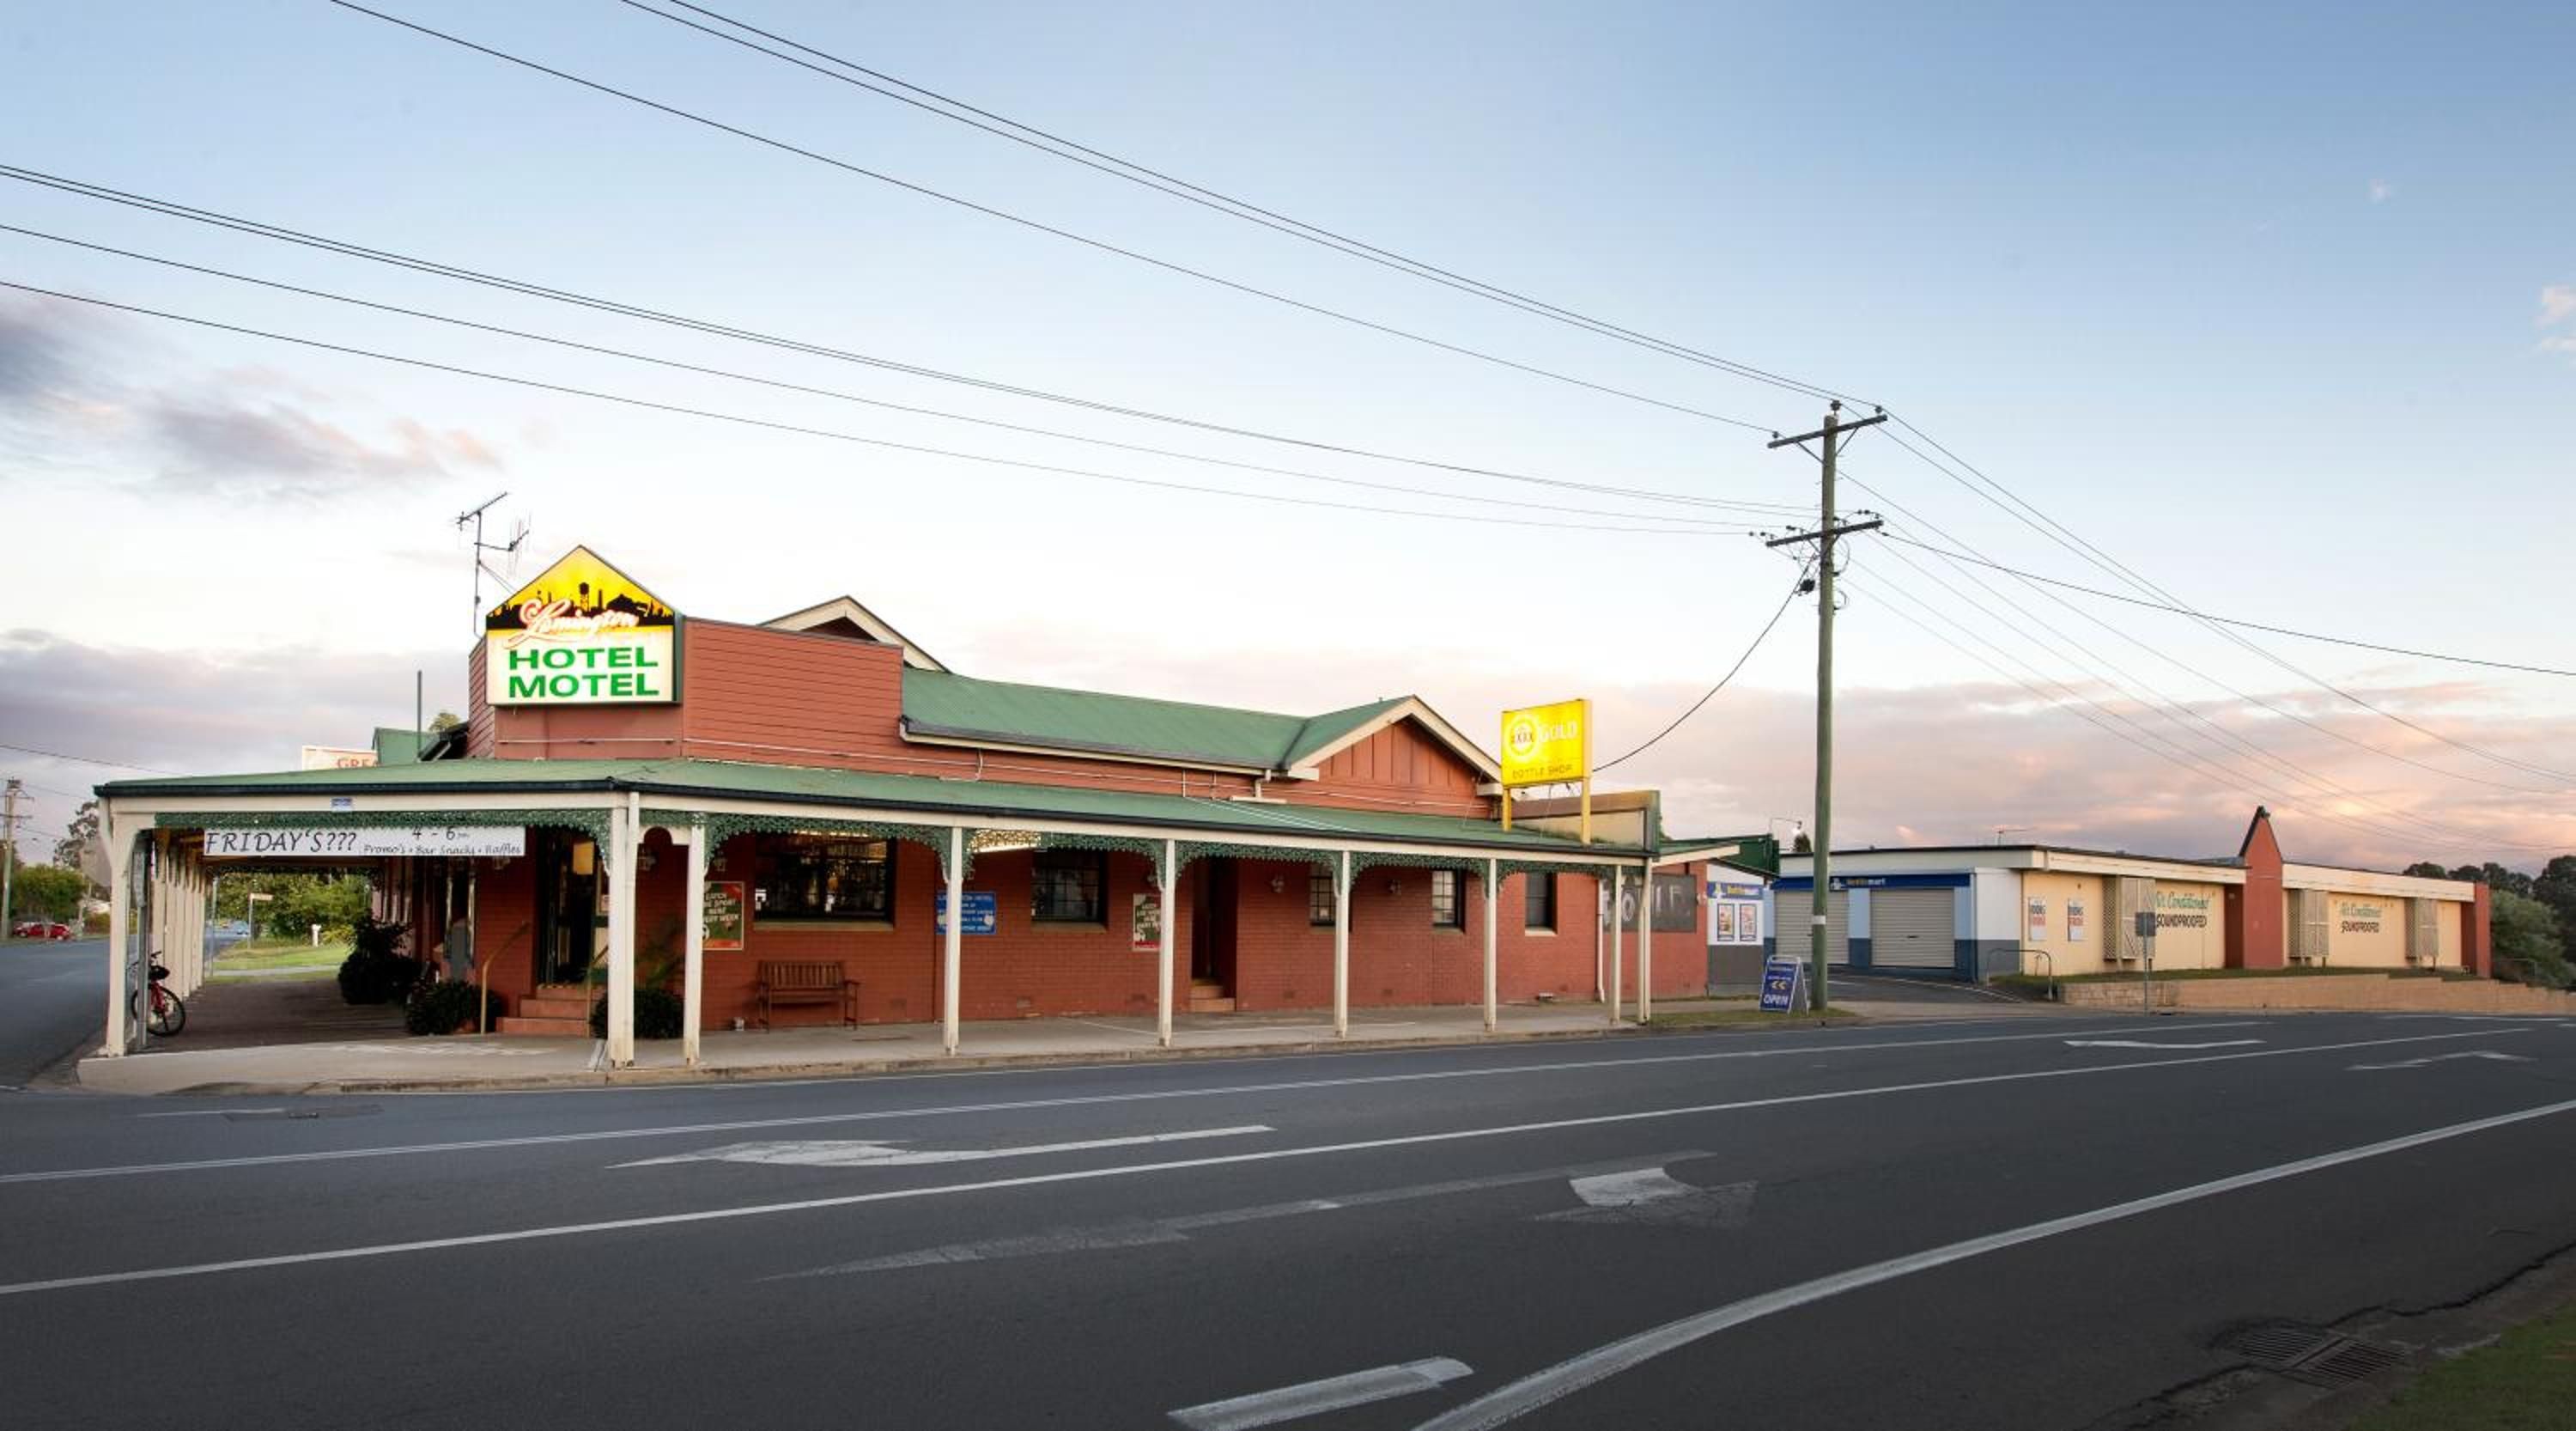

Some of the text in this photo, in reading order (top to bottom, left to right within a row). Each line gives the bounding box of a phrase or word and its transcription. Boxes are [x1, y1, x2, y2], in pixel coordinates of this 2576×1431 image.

[509, 646, 659, 670] HOTEL
[509, 673, 659, 697] MOTEL
[1763, 993, 1789, 1006] OPEN
